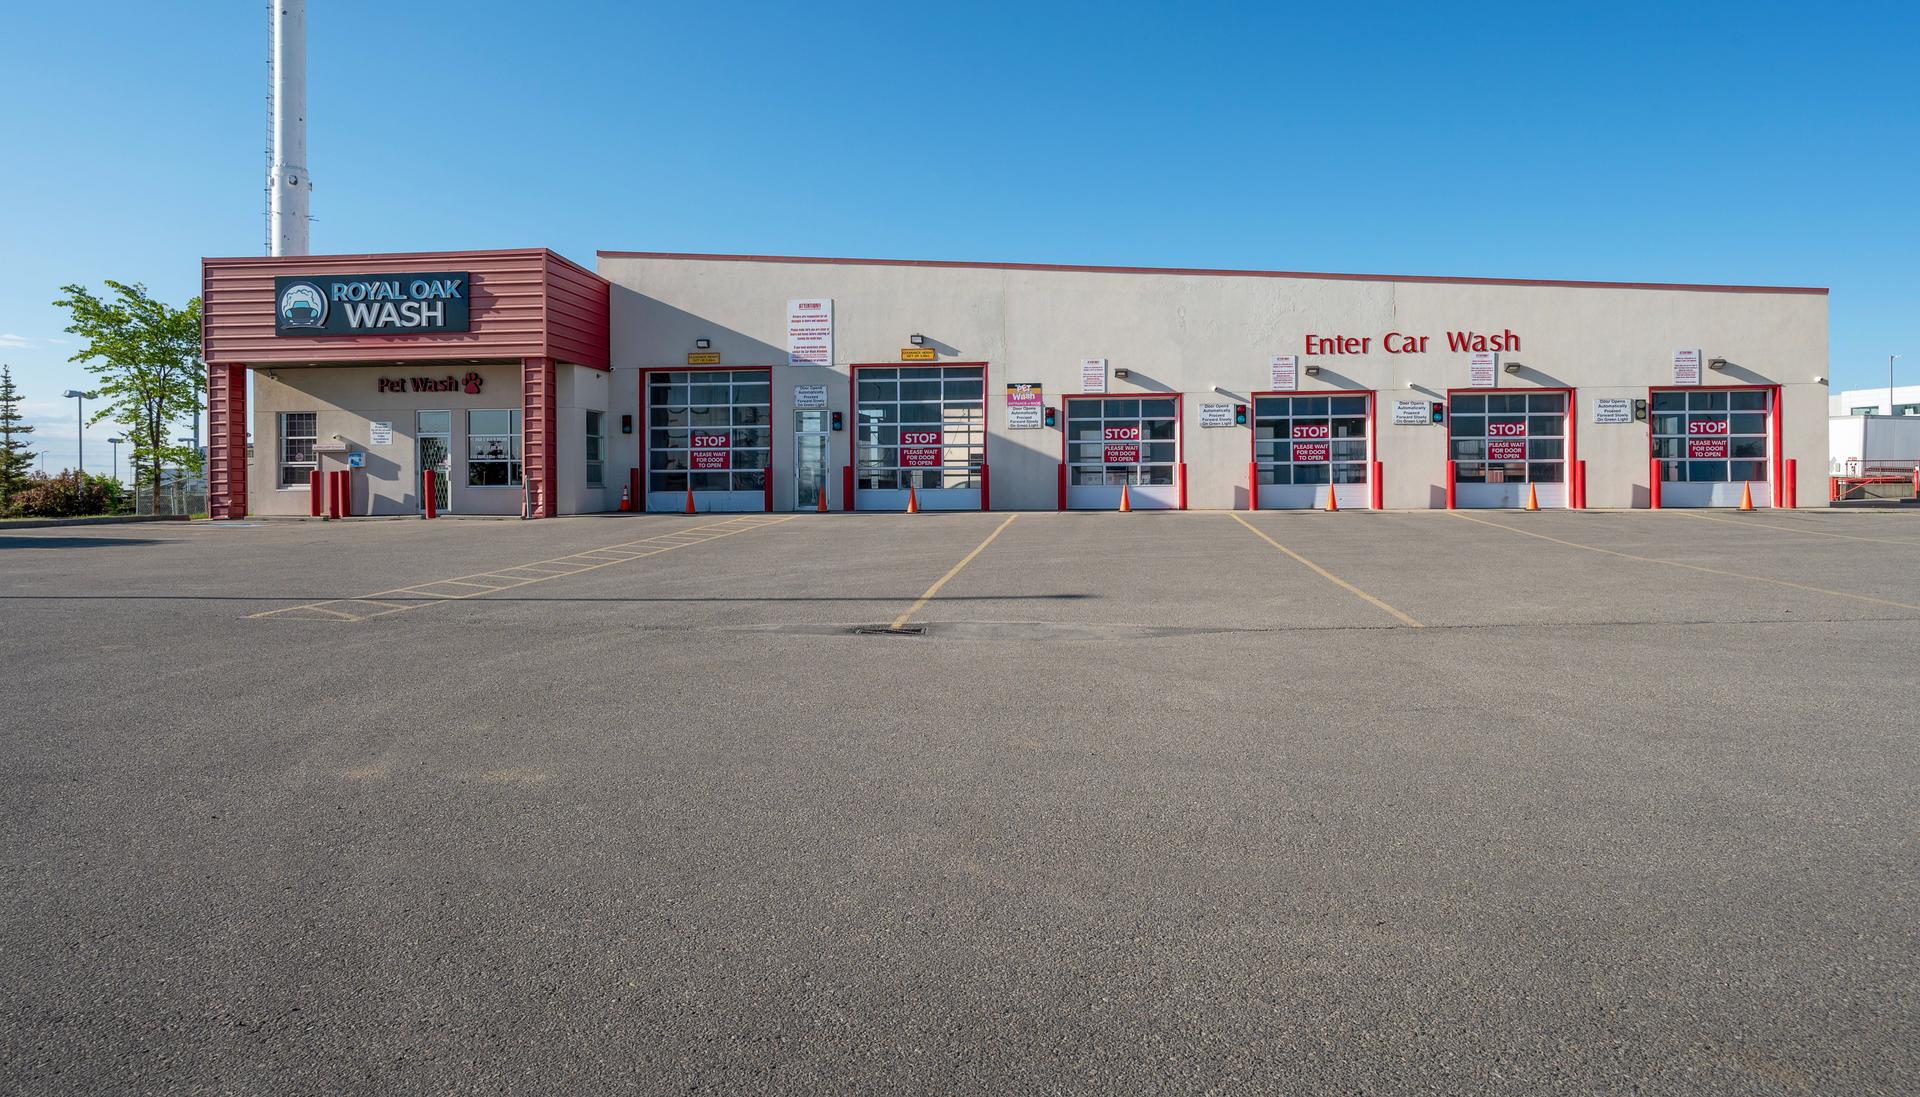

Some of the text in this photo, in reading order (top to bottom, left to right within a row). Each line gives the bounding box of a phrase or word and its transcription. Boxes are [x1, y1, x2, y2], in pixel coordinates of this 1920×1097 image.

[332, 279, 462, 301] ROYAL OAK
[344, 301, 444, 328] WASH
[1305, 329, 1520, 355] Enter Car Wash
[378, 376, 460, 392] Pet Wash
[1012, 392, 1035, 401] Wash
[1293, 426, 1328, 437] STOP
[1489, 424, 1524, 435] STOP
[1690, 422, 1726, 433] STOP
[905, 433, 937, 444] STOP
[1105, 428, 1138, 439] STOP
[695, 436, 726, 447] STOP
